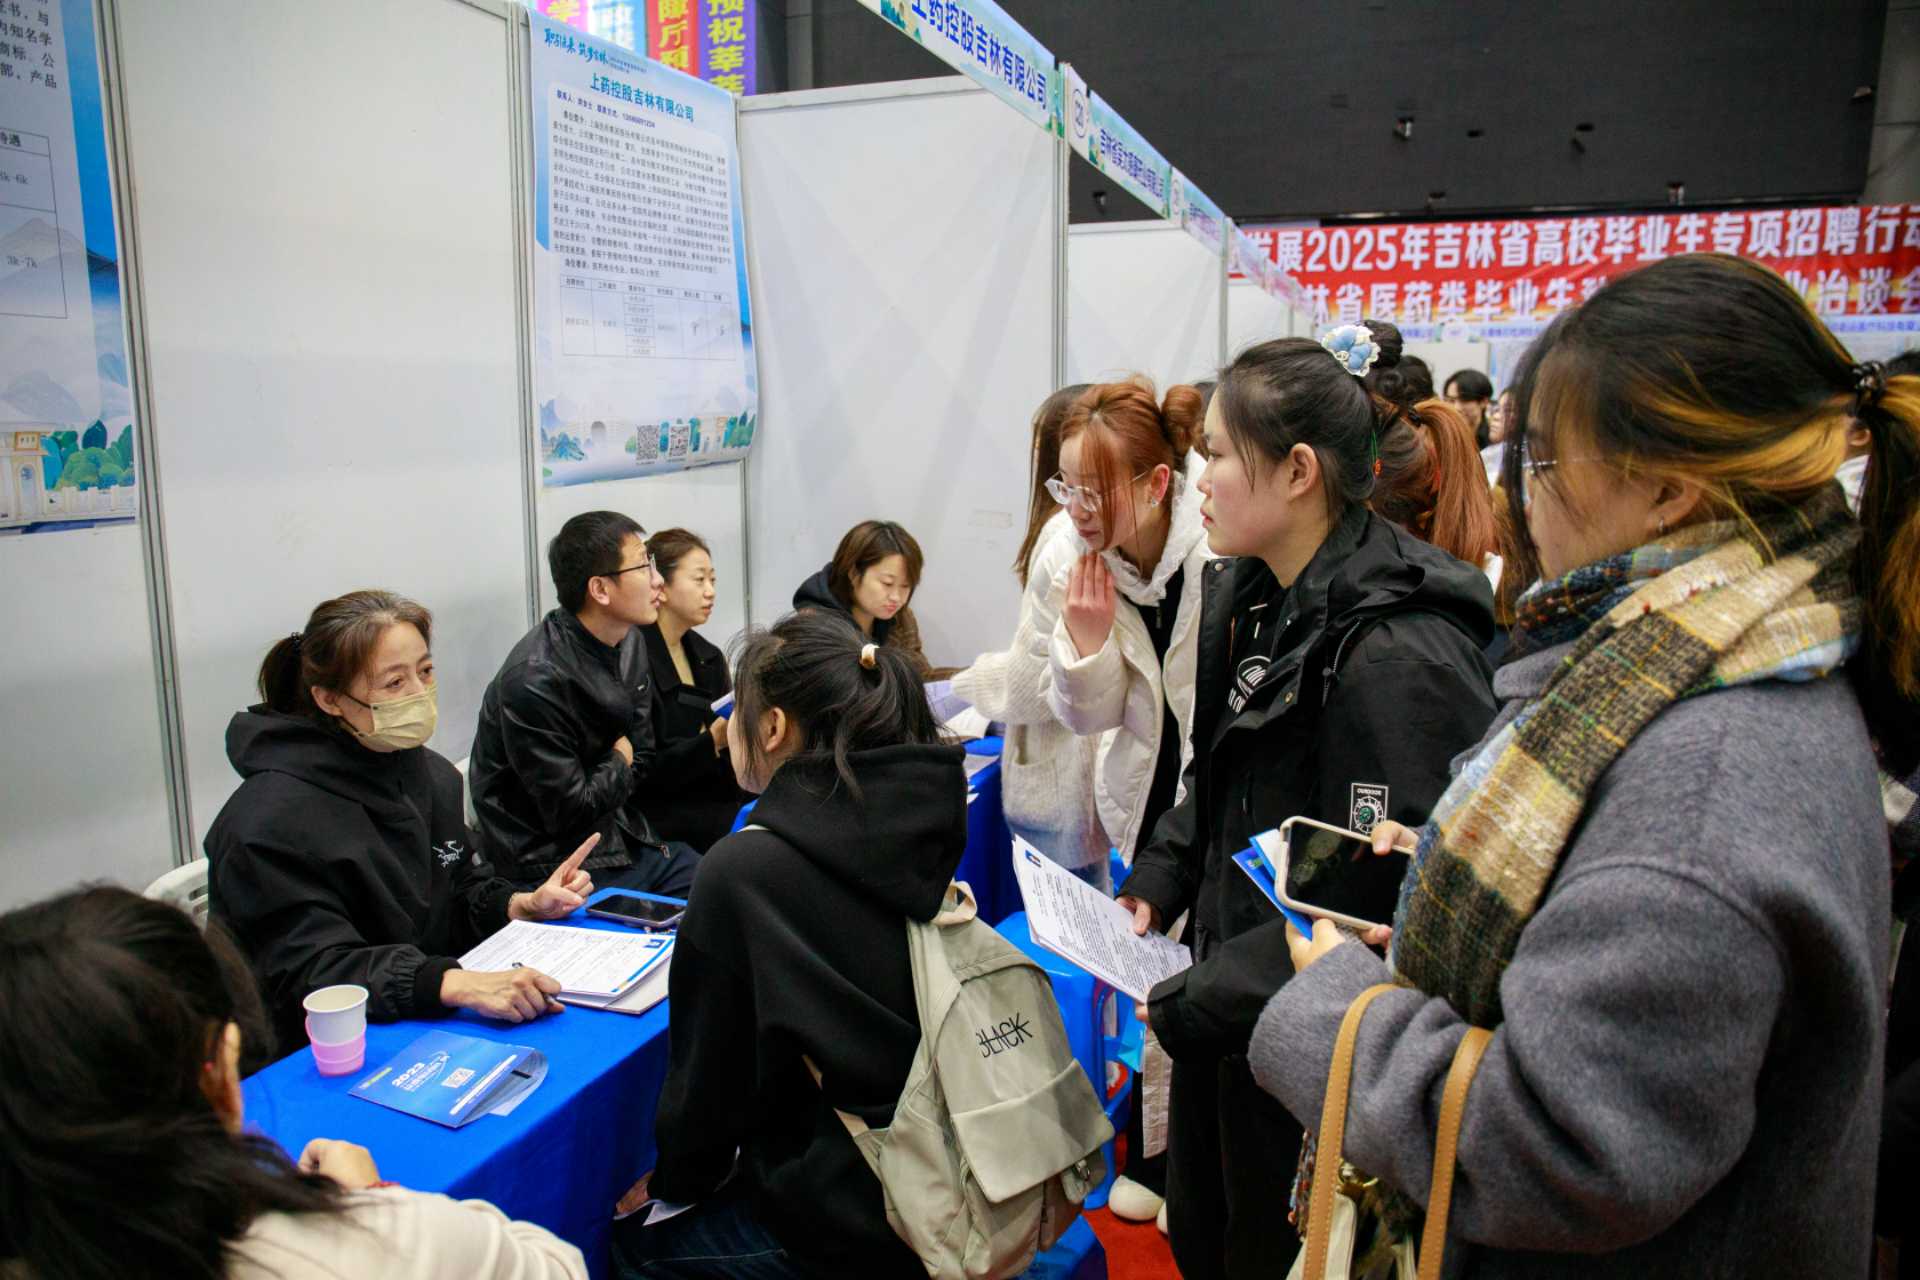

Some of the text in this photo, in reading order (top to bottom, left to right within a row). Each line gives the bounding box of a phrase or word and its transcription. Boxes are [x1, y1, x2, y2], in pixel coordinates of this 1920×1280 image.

[912, 0, 1048, 109] 上药控股吉林有限公司
[590, 73, 694, 122] 上药控股吉林有限公司
